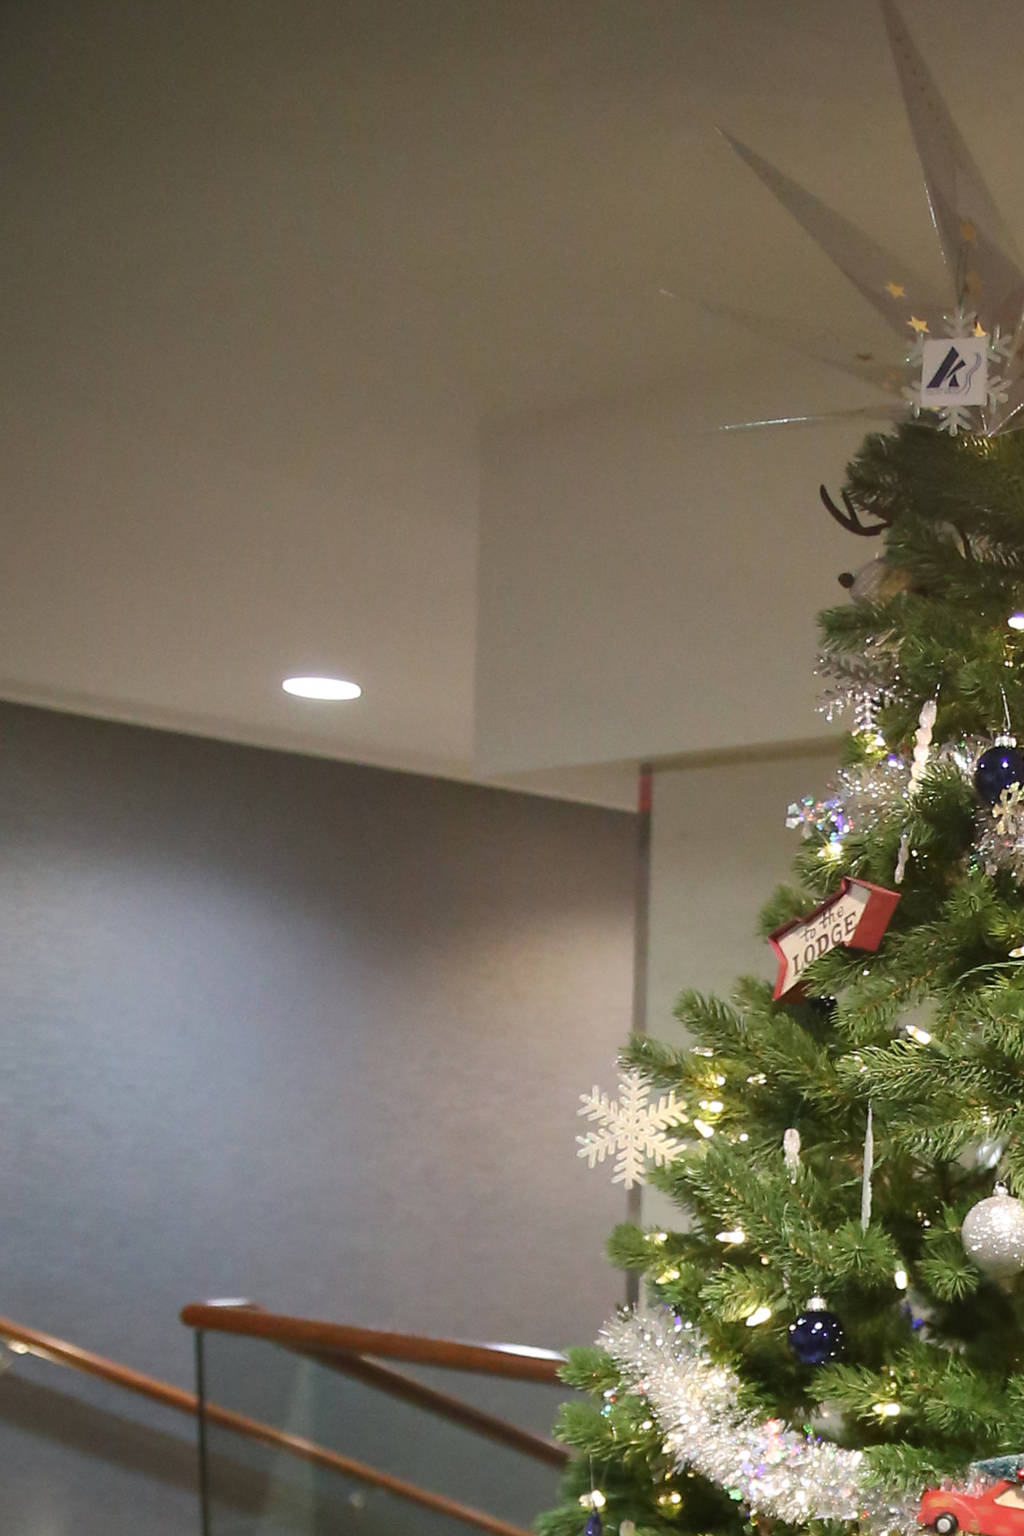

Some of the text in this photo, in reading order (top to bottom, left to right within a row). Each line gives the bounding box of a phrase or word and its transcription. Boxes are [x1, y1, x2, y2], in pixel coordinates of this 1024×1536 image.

[792, 911, 856, 977] LODGE
[801, 906, 844, 942] to the
